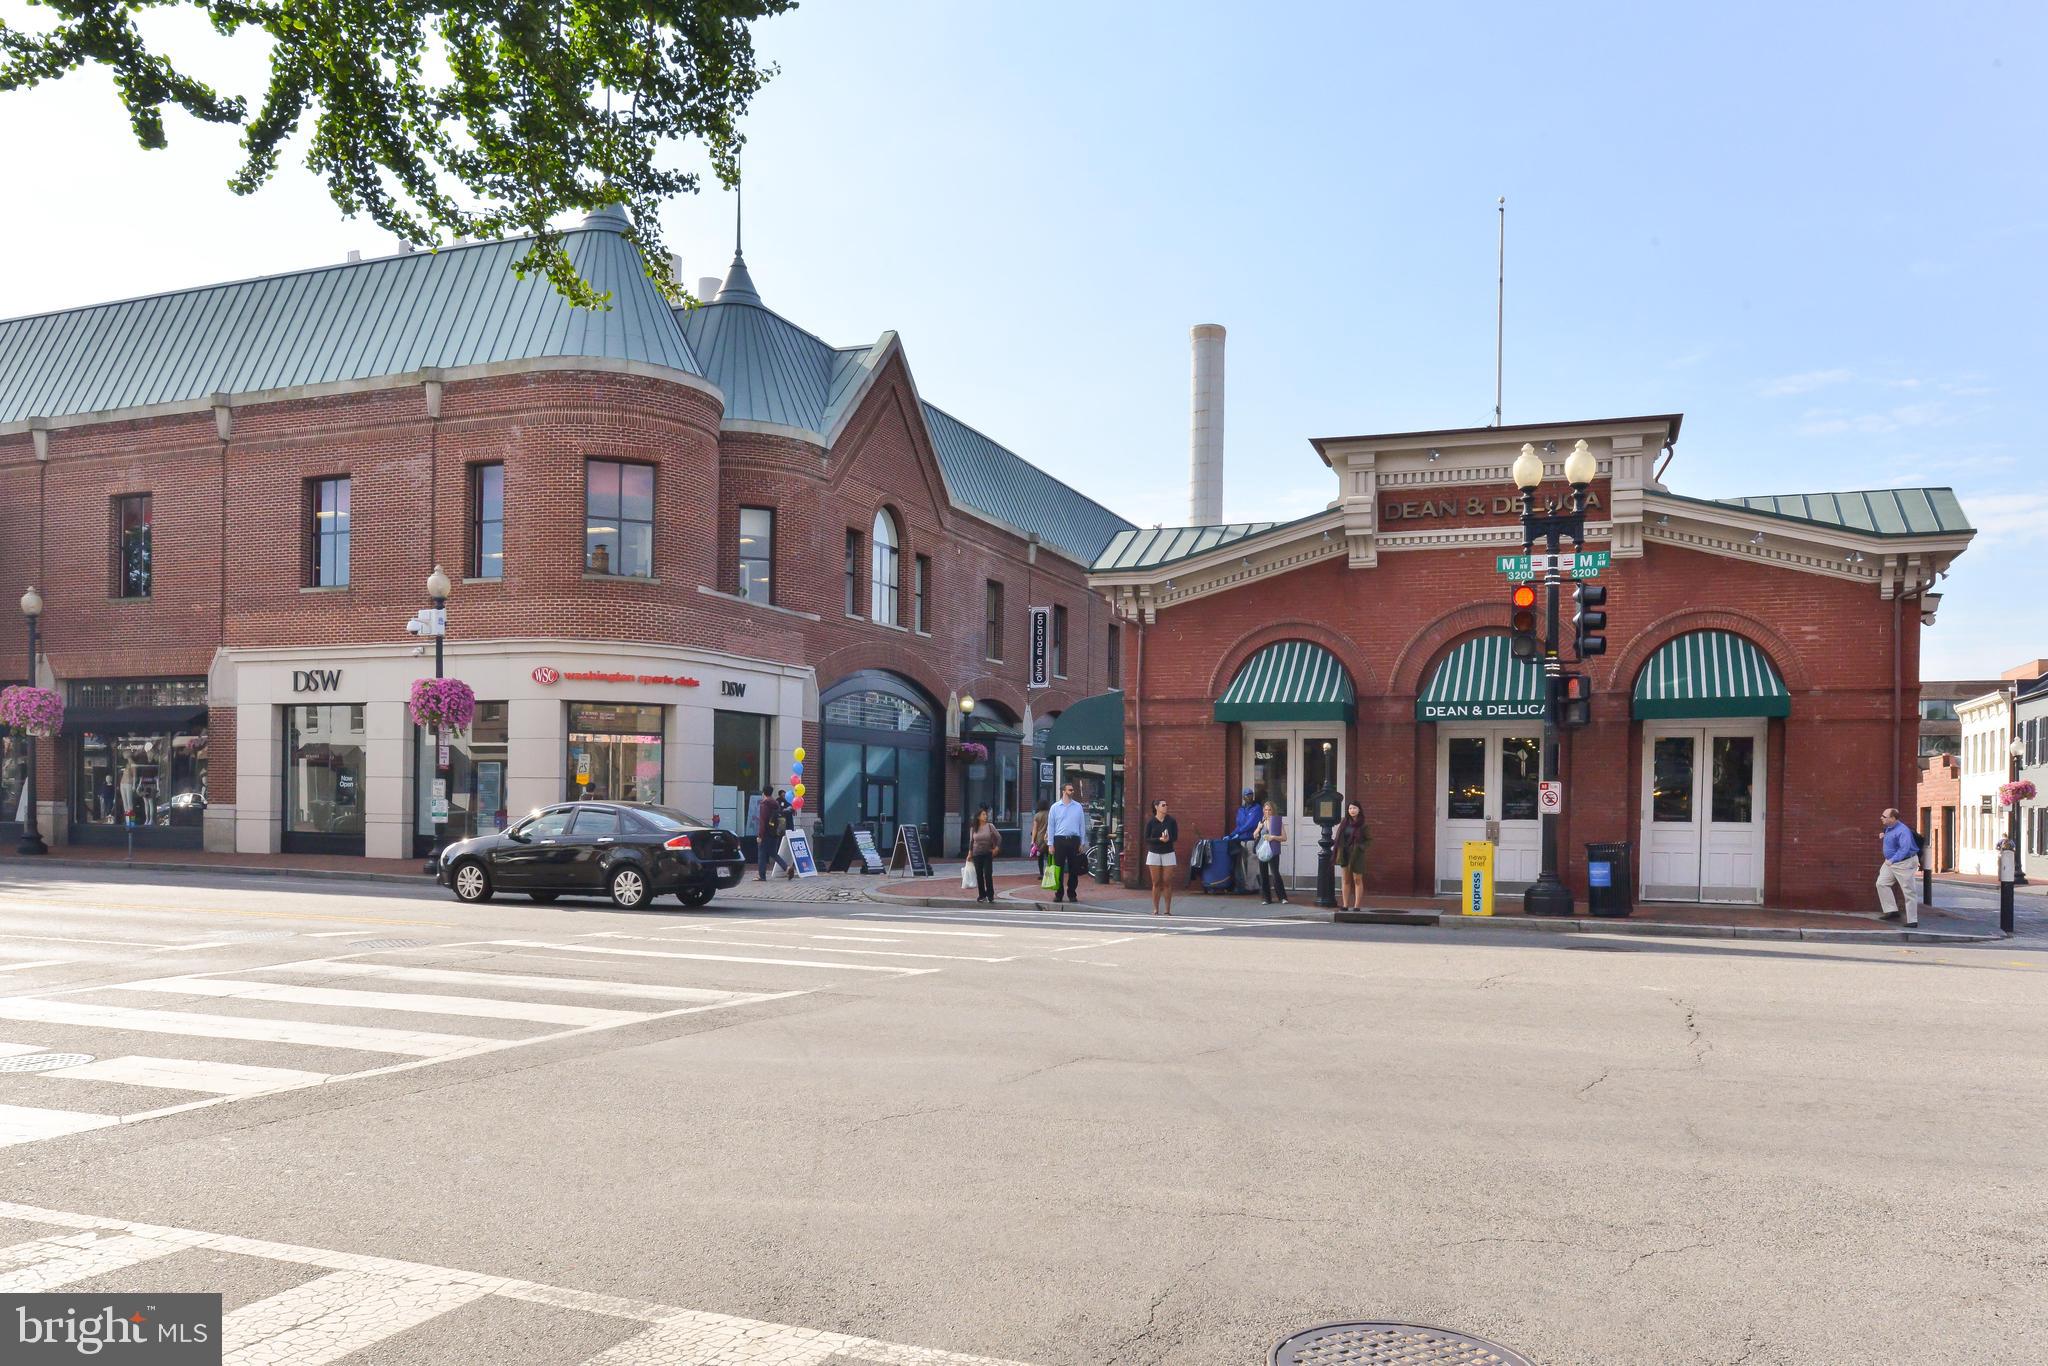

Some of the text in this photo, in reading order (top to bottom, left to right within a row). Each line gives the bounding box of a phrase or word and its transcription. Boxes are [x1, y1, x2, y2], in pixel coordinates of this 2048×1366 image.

[1384, 500, 1458, 520] DEAN
[1466, 496, 1485, 516] &
[1502, 558, 1515, 570] M
[1580, 555, 1593, 567] M
[1508, 571, 1534, 580] 3200
[1572, 568, 1598, 578] 3200
[1035, 613, 1044, 682] olivia macaron
[292, 669, 343, 692] DSW
[534, 667, 555, 683] WSC
[721, 680, 746, 697] DSW
[1425, 706, 1468, 717] DEAN
[1472, 705, 1482, 716] &
[791, 841, 806, 851] OPEN
[794, 849, 809, 858] HOUSE
[1473, 872, 1482, 911] express
